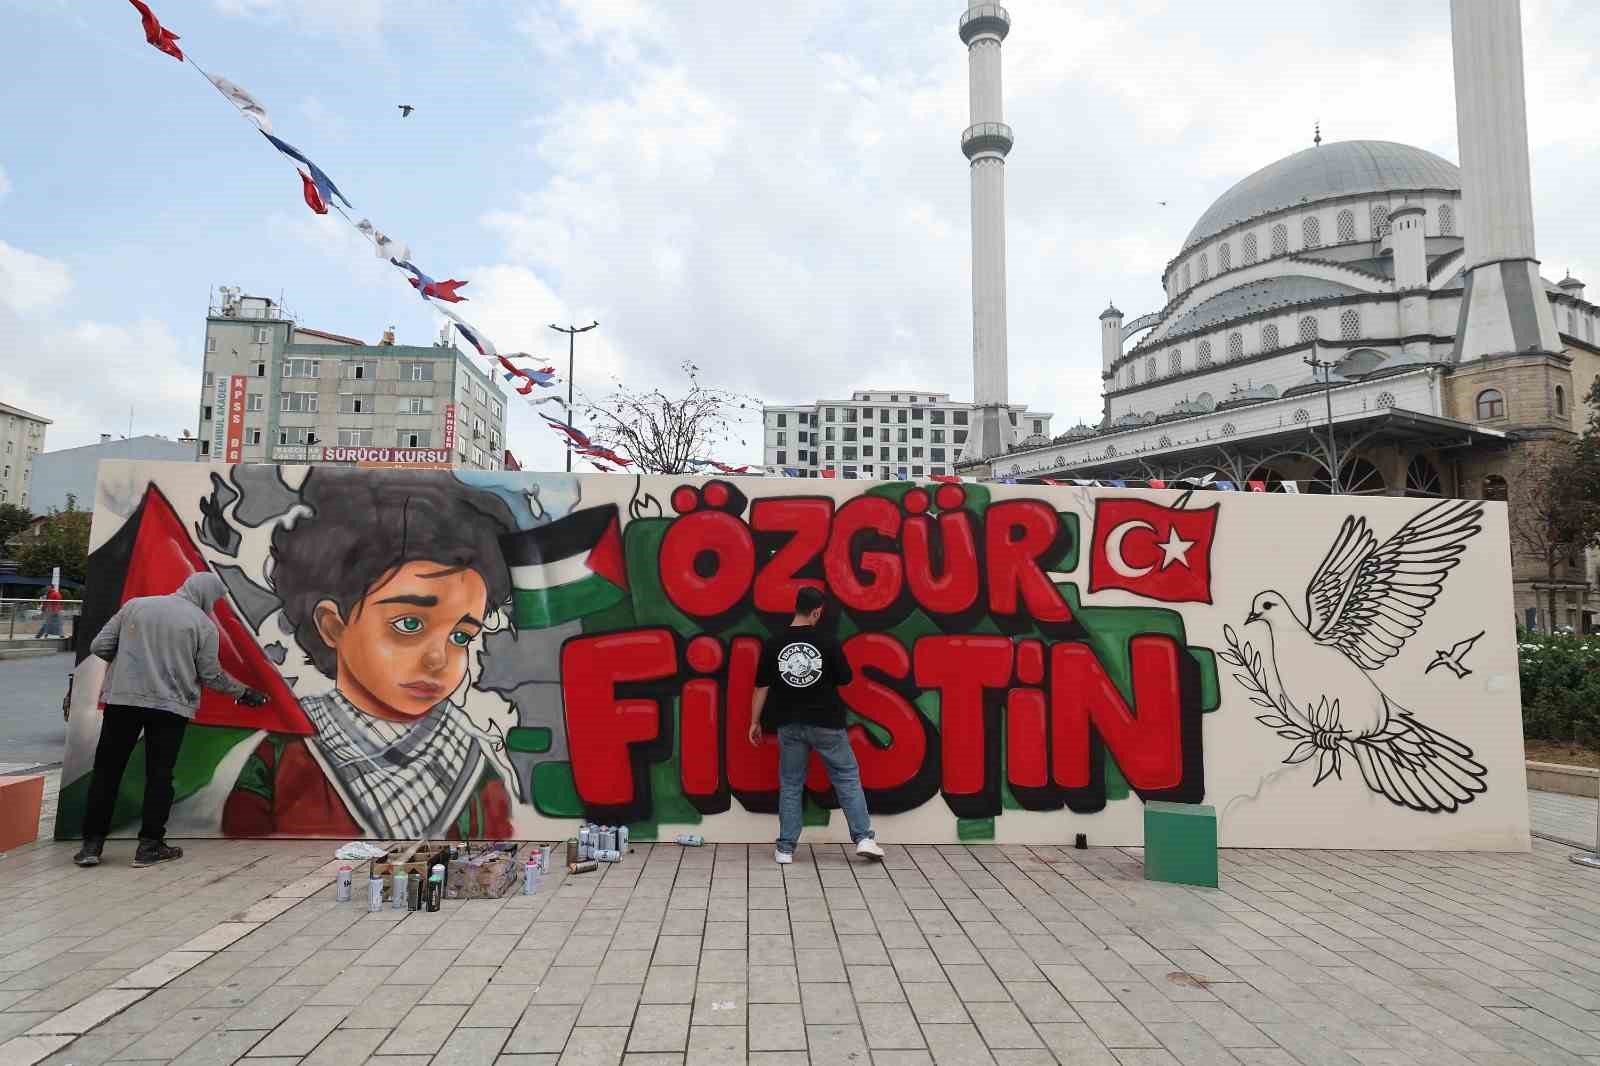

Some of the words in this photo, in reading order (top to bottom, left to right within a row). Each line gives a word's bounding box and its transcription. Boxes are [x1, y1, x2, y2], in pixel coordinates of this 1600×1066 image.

[232, 379, 242, 424] KPSS
[325, 447, 390, 461] SÜRÜCÜ
[394, 451, 448, 463] KURSU
[658, 482, 1073, 623] ÖZGÜR
[789, 675, 814, 684] CLUB
